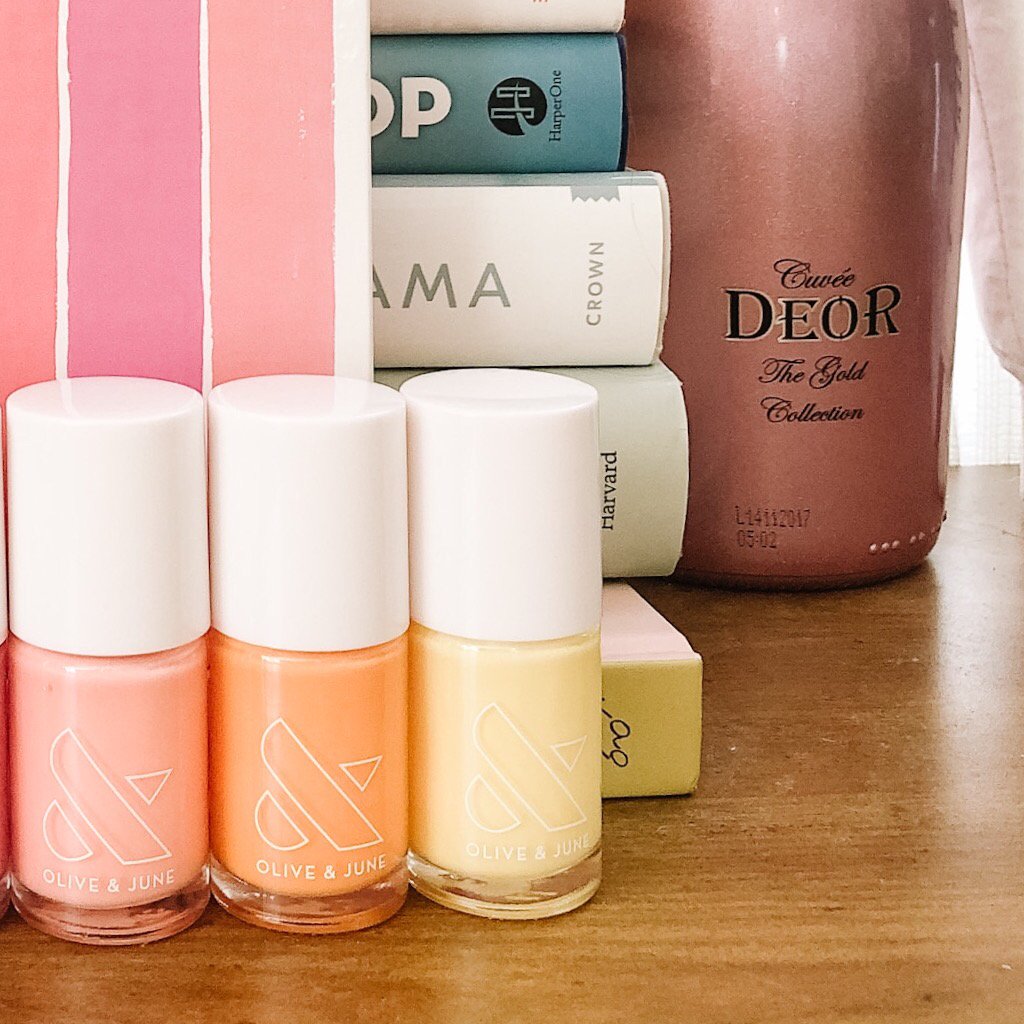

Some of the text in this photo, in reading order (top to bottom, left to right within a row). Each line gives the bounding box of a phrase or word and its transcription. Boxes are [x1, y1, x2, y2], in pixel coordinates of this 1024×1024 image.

[548, 70, 566, 143] HarperOne
[586, 242, 604, 326] CROWN
[773, 258, 856, 289] Cuvée
[723, 284, 901, 343] DEOR
[759, 355, 869, 390] The Gold
[761, 396, 865, 423] Collection
[600, 450, 617, 530] Harvard
[466, 834, 590, 862] OLIVE & JUNE
[43, 869, 175, 893] OLIVE & JUNE
[256, 854, 387, 881] OLIVE & JUNE
